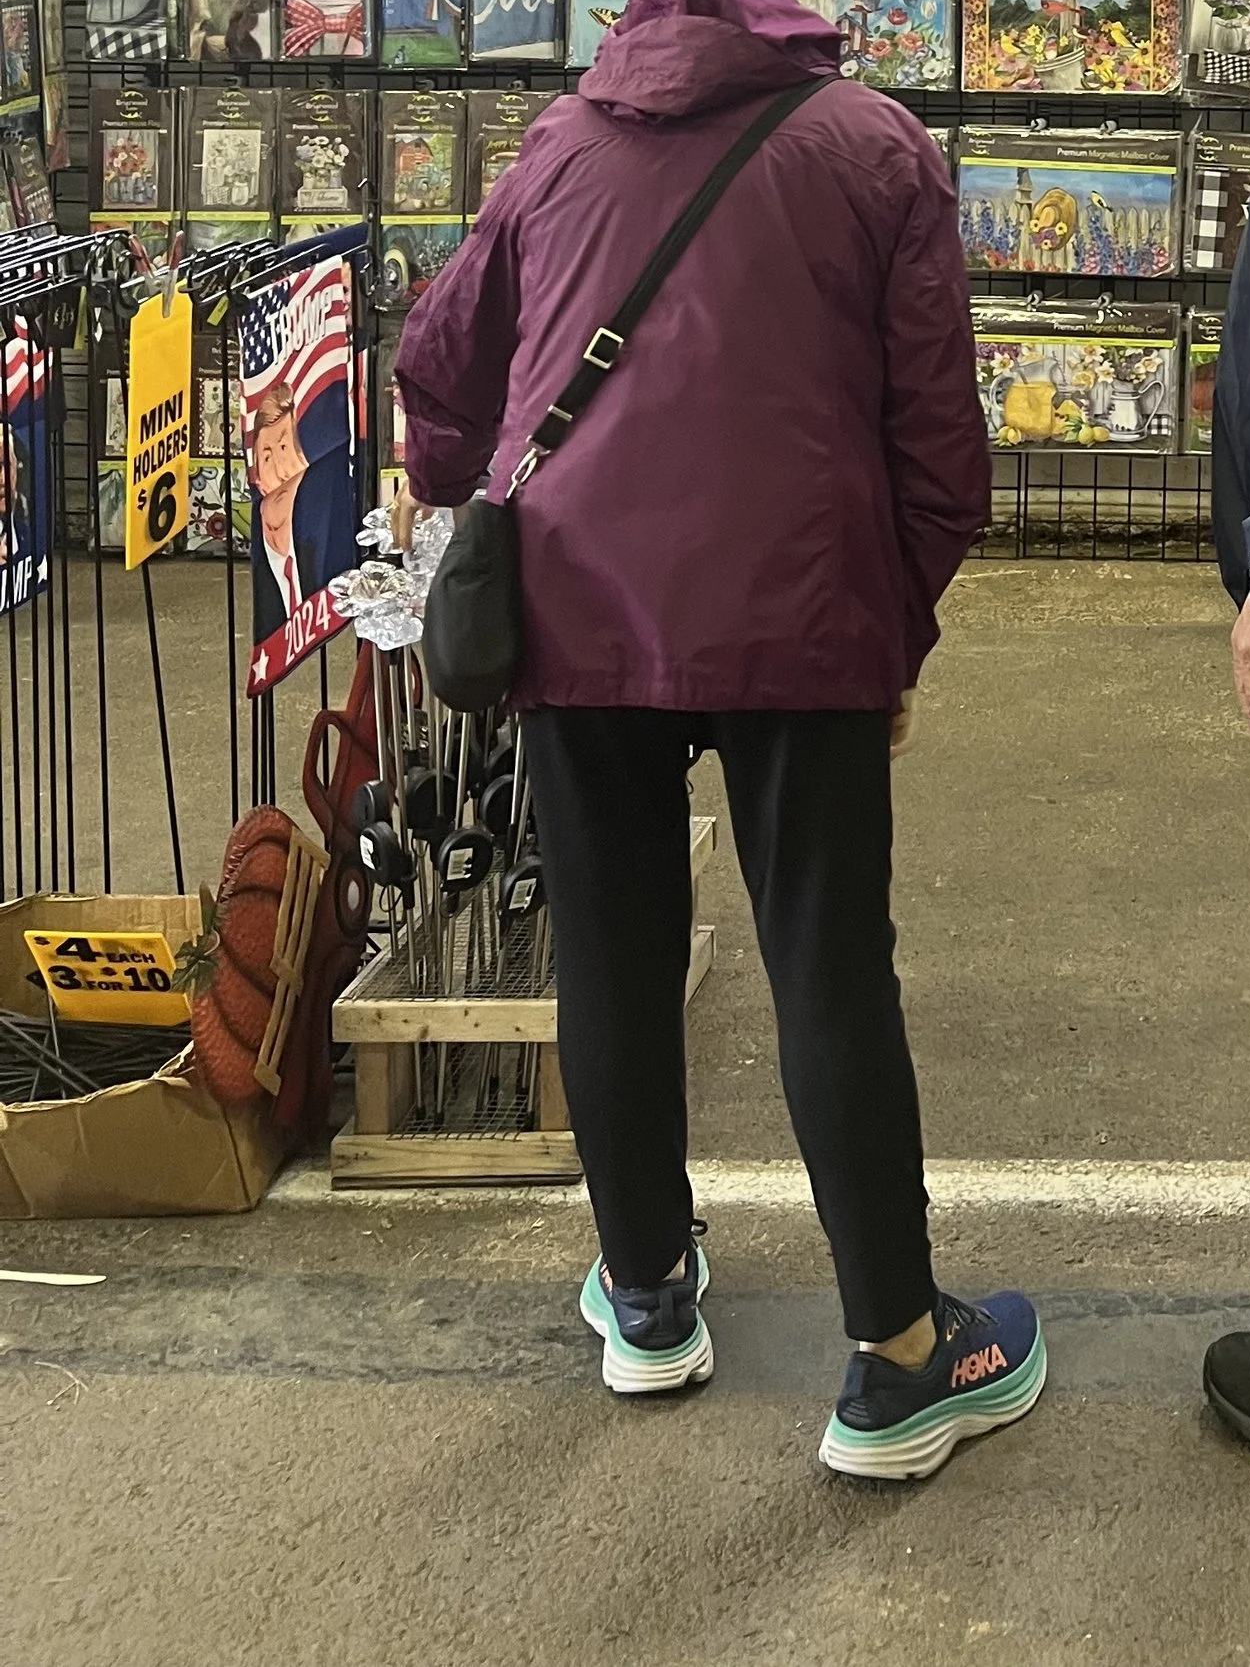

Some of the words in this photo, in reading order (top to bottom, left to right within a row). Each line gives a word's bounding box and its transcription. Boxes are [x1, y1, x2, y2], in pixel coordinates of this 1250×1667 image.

[1057, 147, 1088, 157] Premium
[265, 287, 333, 365] TRUMP
[1053, 322, 1084, 332] Premium
[140, 390, 183, 444] MINI
[133, 424, 188, 486] HOLDERS
[137, 472, 176, 542] $6
[285, 590, 331, 667] 2024
[48, 965, 82, 990] 3
[86, 981, 124, 991] FOR
[106, 953, 156, 963] EACH
[952, 1343, 1007, 1388] HOKA
